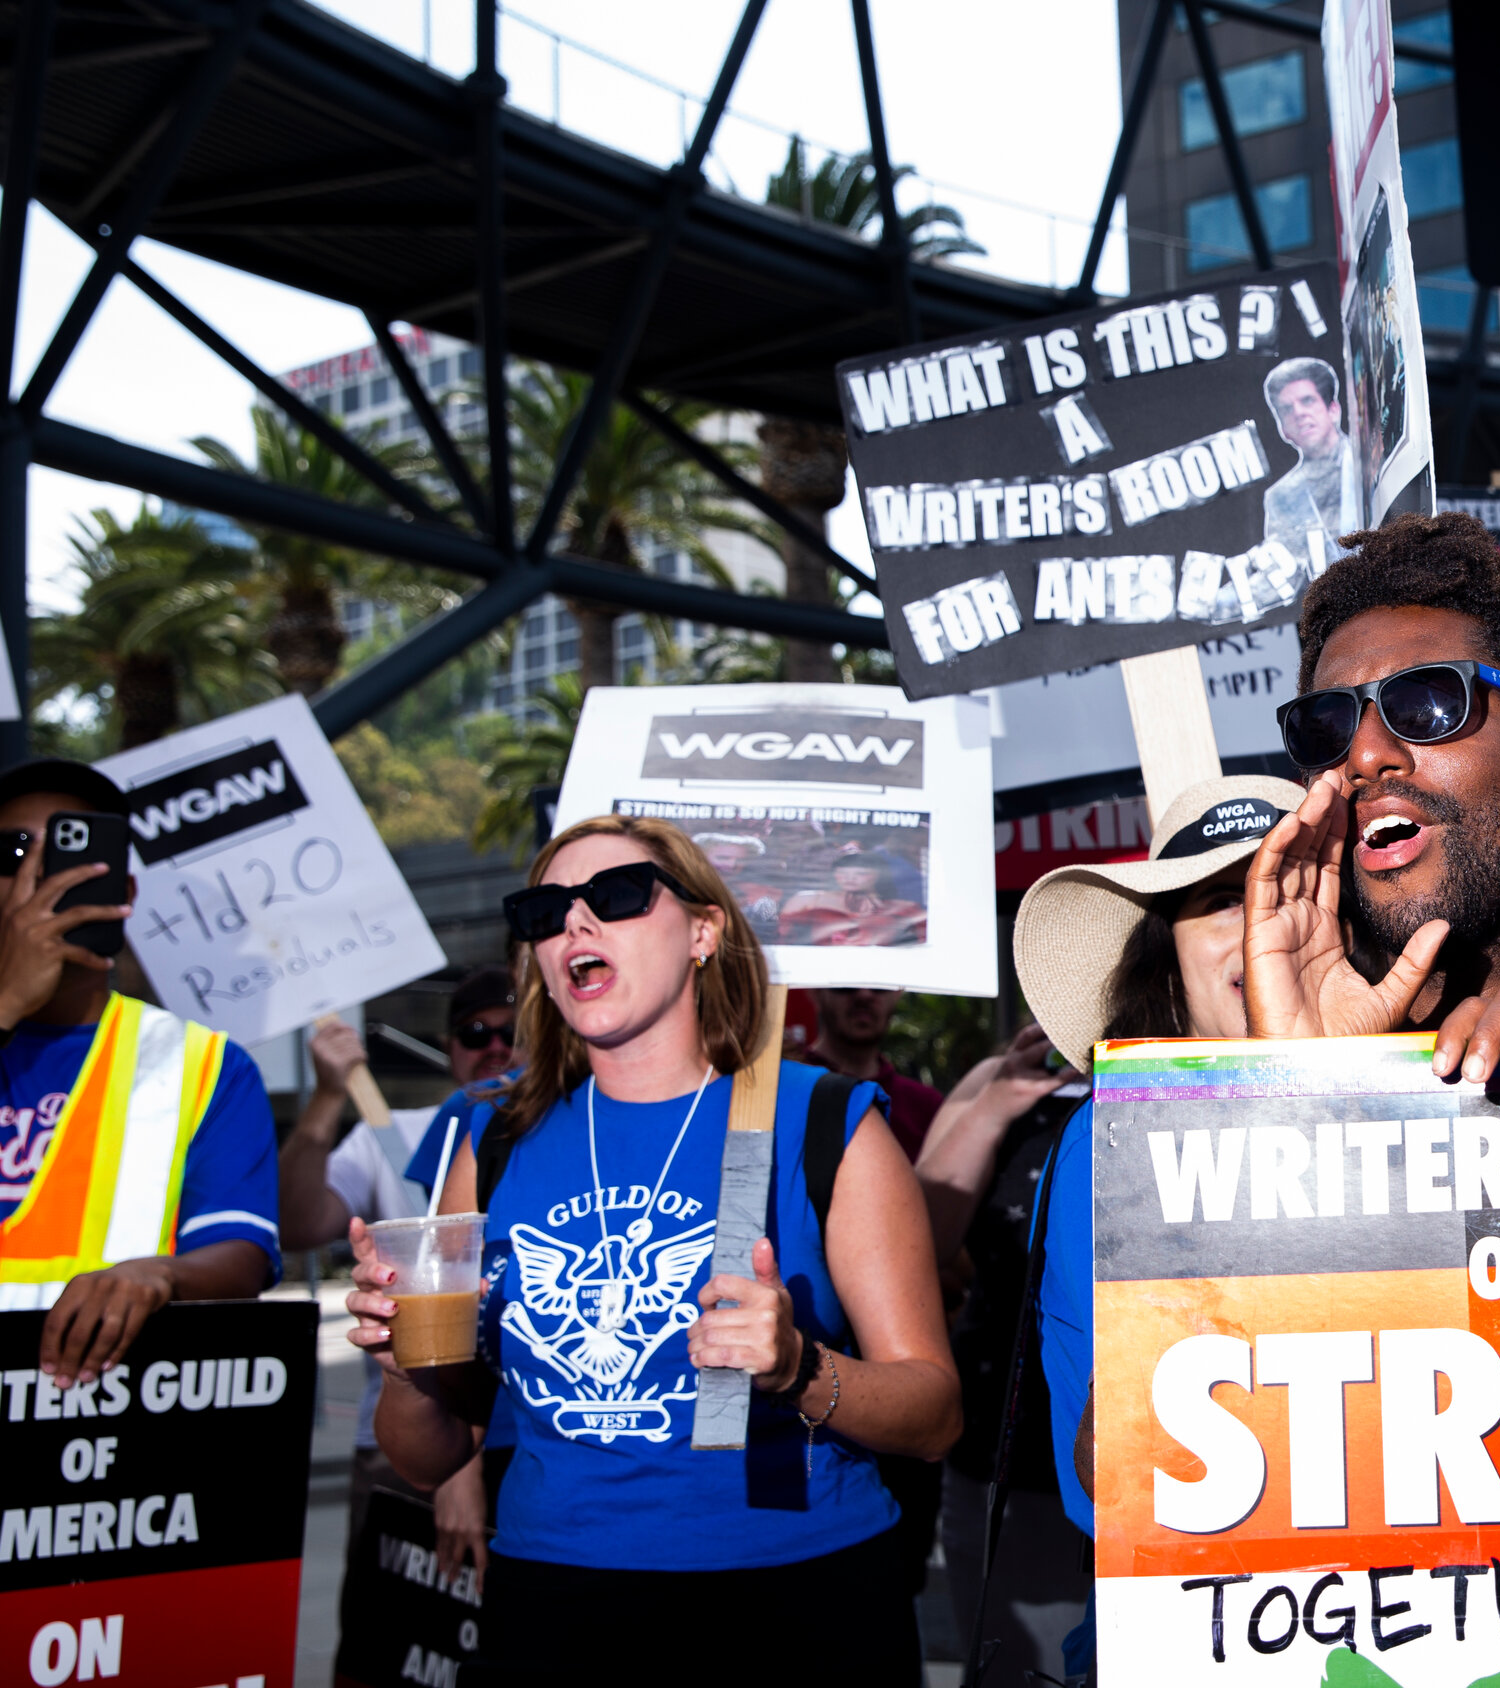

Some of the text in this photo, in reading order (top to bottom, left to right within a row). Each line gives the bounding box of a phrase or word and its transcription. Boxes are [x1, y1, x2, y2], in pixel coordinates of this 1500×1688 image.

[847, 346, 1007, 434] WHAT
[1022, 327, 1088, 394] IS
[1053, 398, 1103, 465] A
[871, 425, 1266, 547] WRITER'S ROOM
[904, 574, 1024, 666] FOR
[656, 732, 916, 767] WGAW
[129, 759, 287, 842] WGAW
[617, 800, 715, 820] STRIKING
[715, 804, 738, 820] IS
[739, 804, 767, 821] SO
[810, 807, 871, 825] RIGHT
[871, 811, 921, 829] NOW
[1202, 814, 1272, 837] CAPTAIN
[1215, 802, 1256, 820] WGA
[180, 910, 397, 1017] Residuals
[546, 1184, 703, 1228] GUILD OF
[0, 1356, 288, 1422] TERS GUILD
[581, 1412, 642, 1430] WEST
[60, 1436, 118, 1483] OF
[28, 1614, 124, 1688] ON
